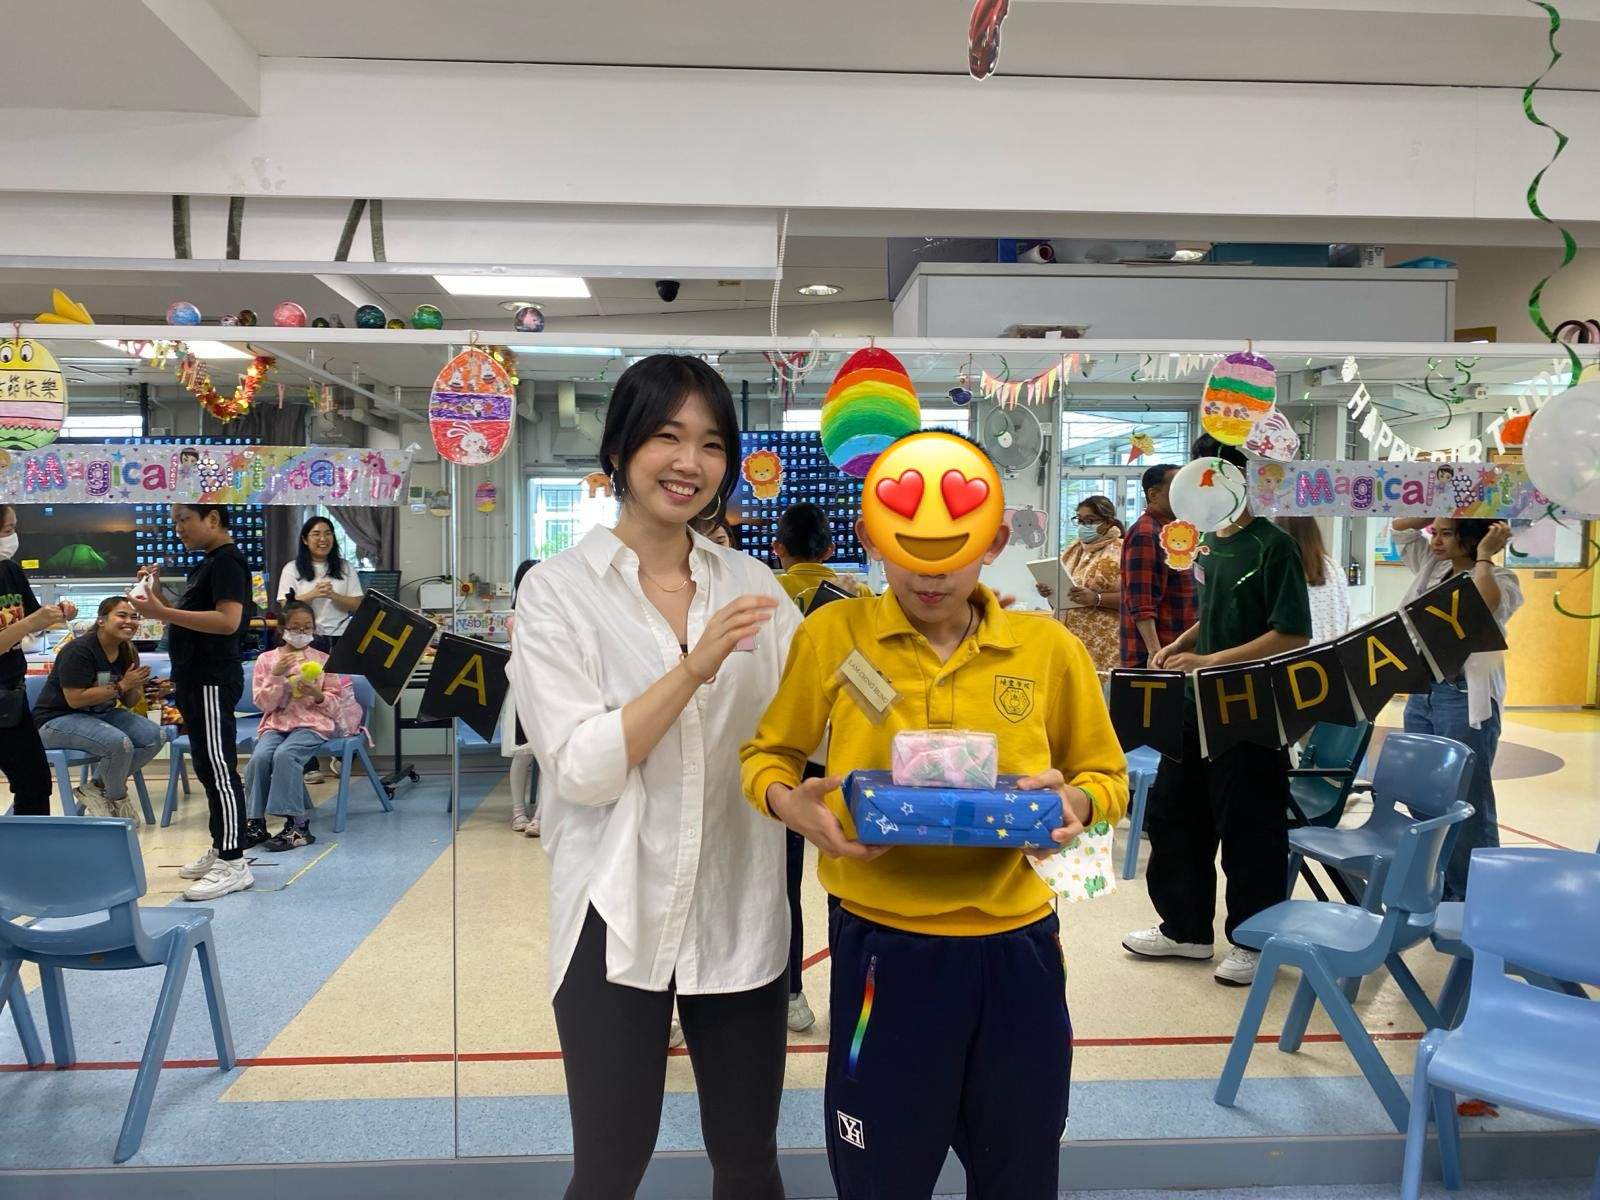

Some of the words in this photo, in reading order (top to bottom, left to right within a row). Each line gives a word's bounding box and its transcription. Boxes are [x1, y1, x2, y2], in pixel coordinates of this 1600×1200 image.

[0, 374, 58, 398] 節快樂
[24, 450, 179, 497] Magical
[1296, 467, 1436, 511] Magical
